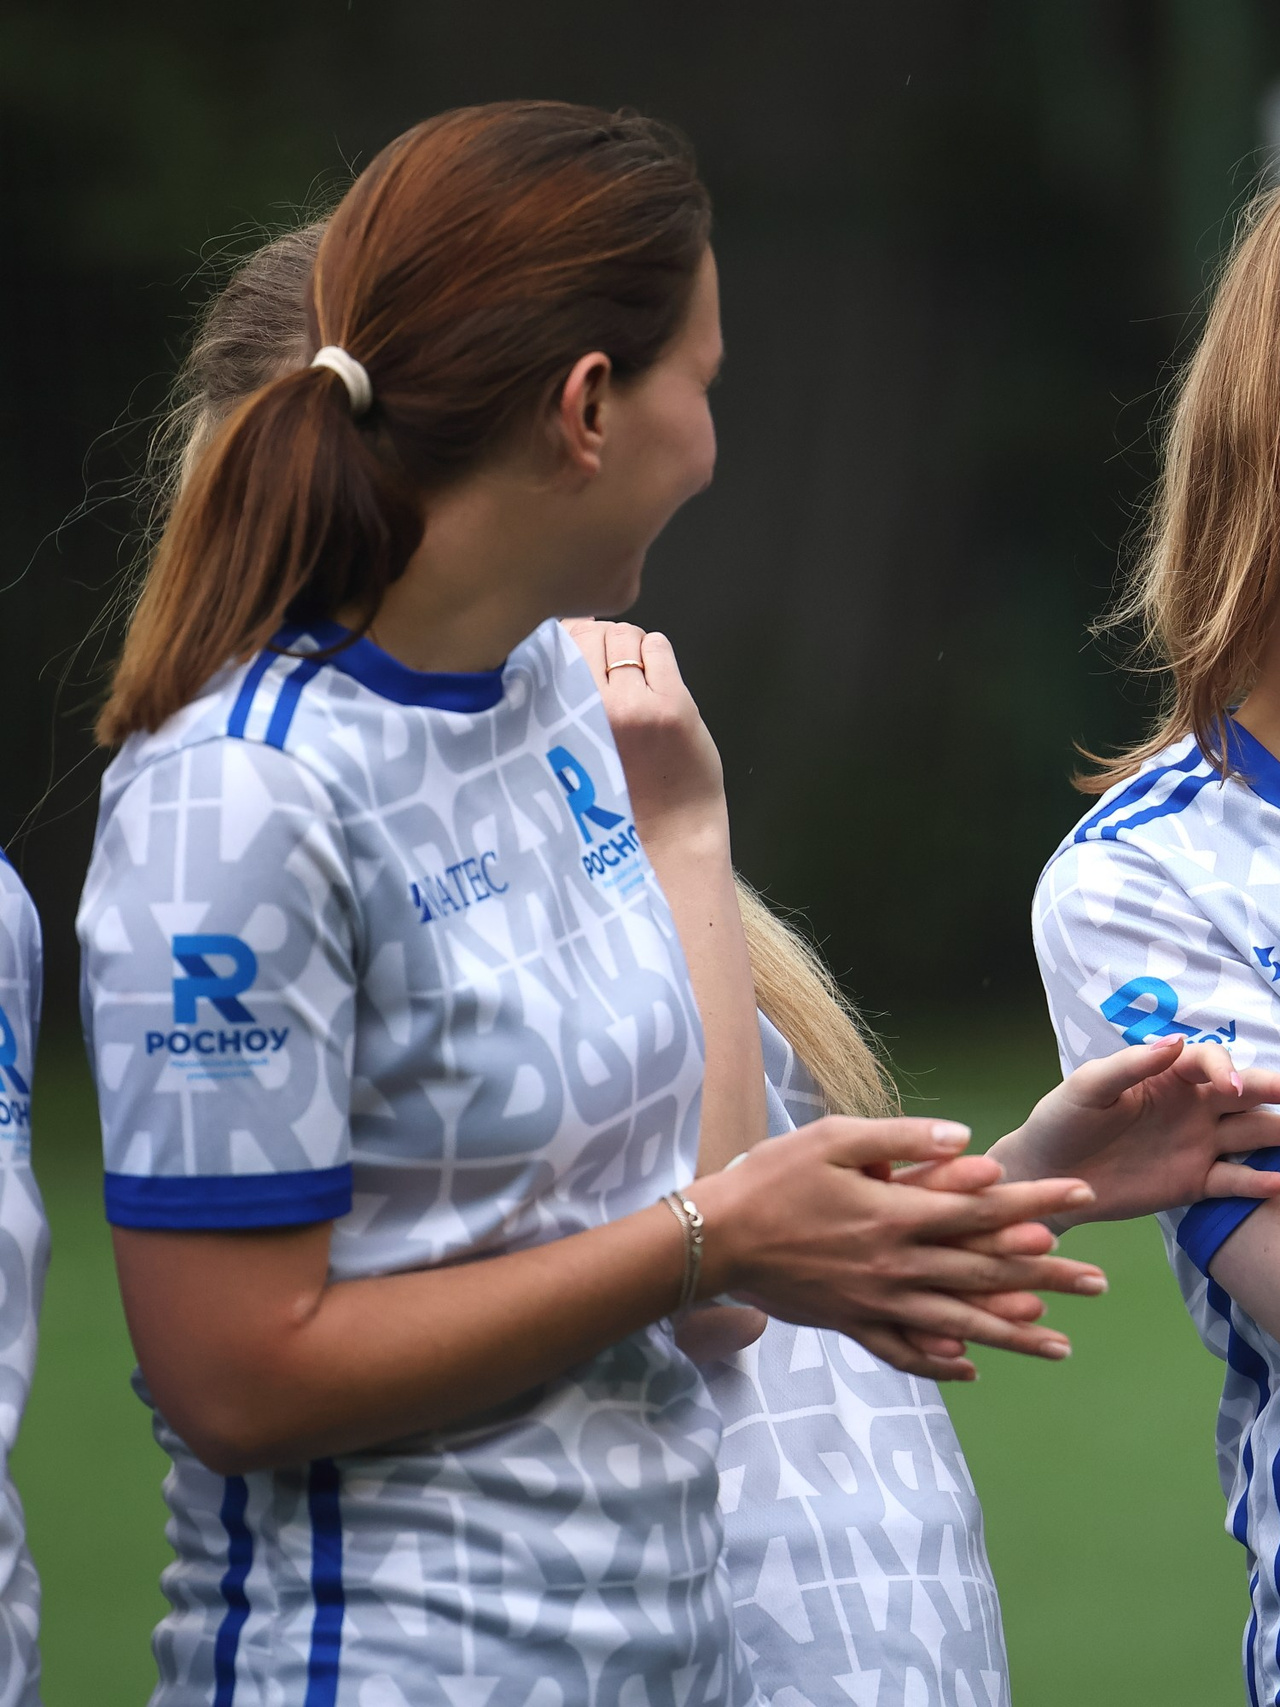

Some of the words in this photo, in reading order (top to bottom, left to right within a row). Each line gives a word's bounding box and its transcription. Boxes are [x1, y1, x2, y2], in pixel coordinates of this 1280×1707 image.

[582, 824, 639, 881] РОСН
[172, 934, 258, 1025] R
[145, 1026, 289, 1057] РОСНОУ
